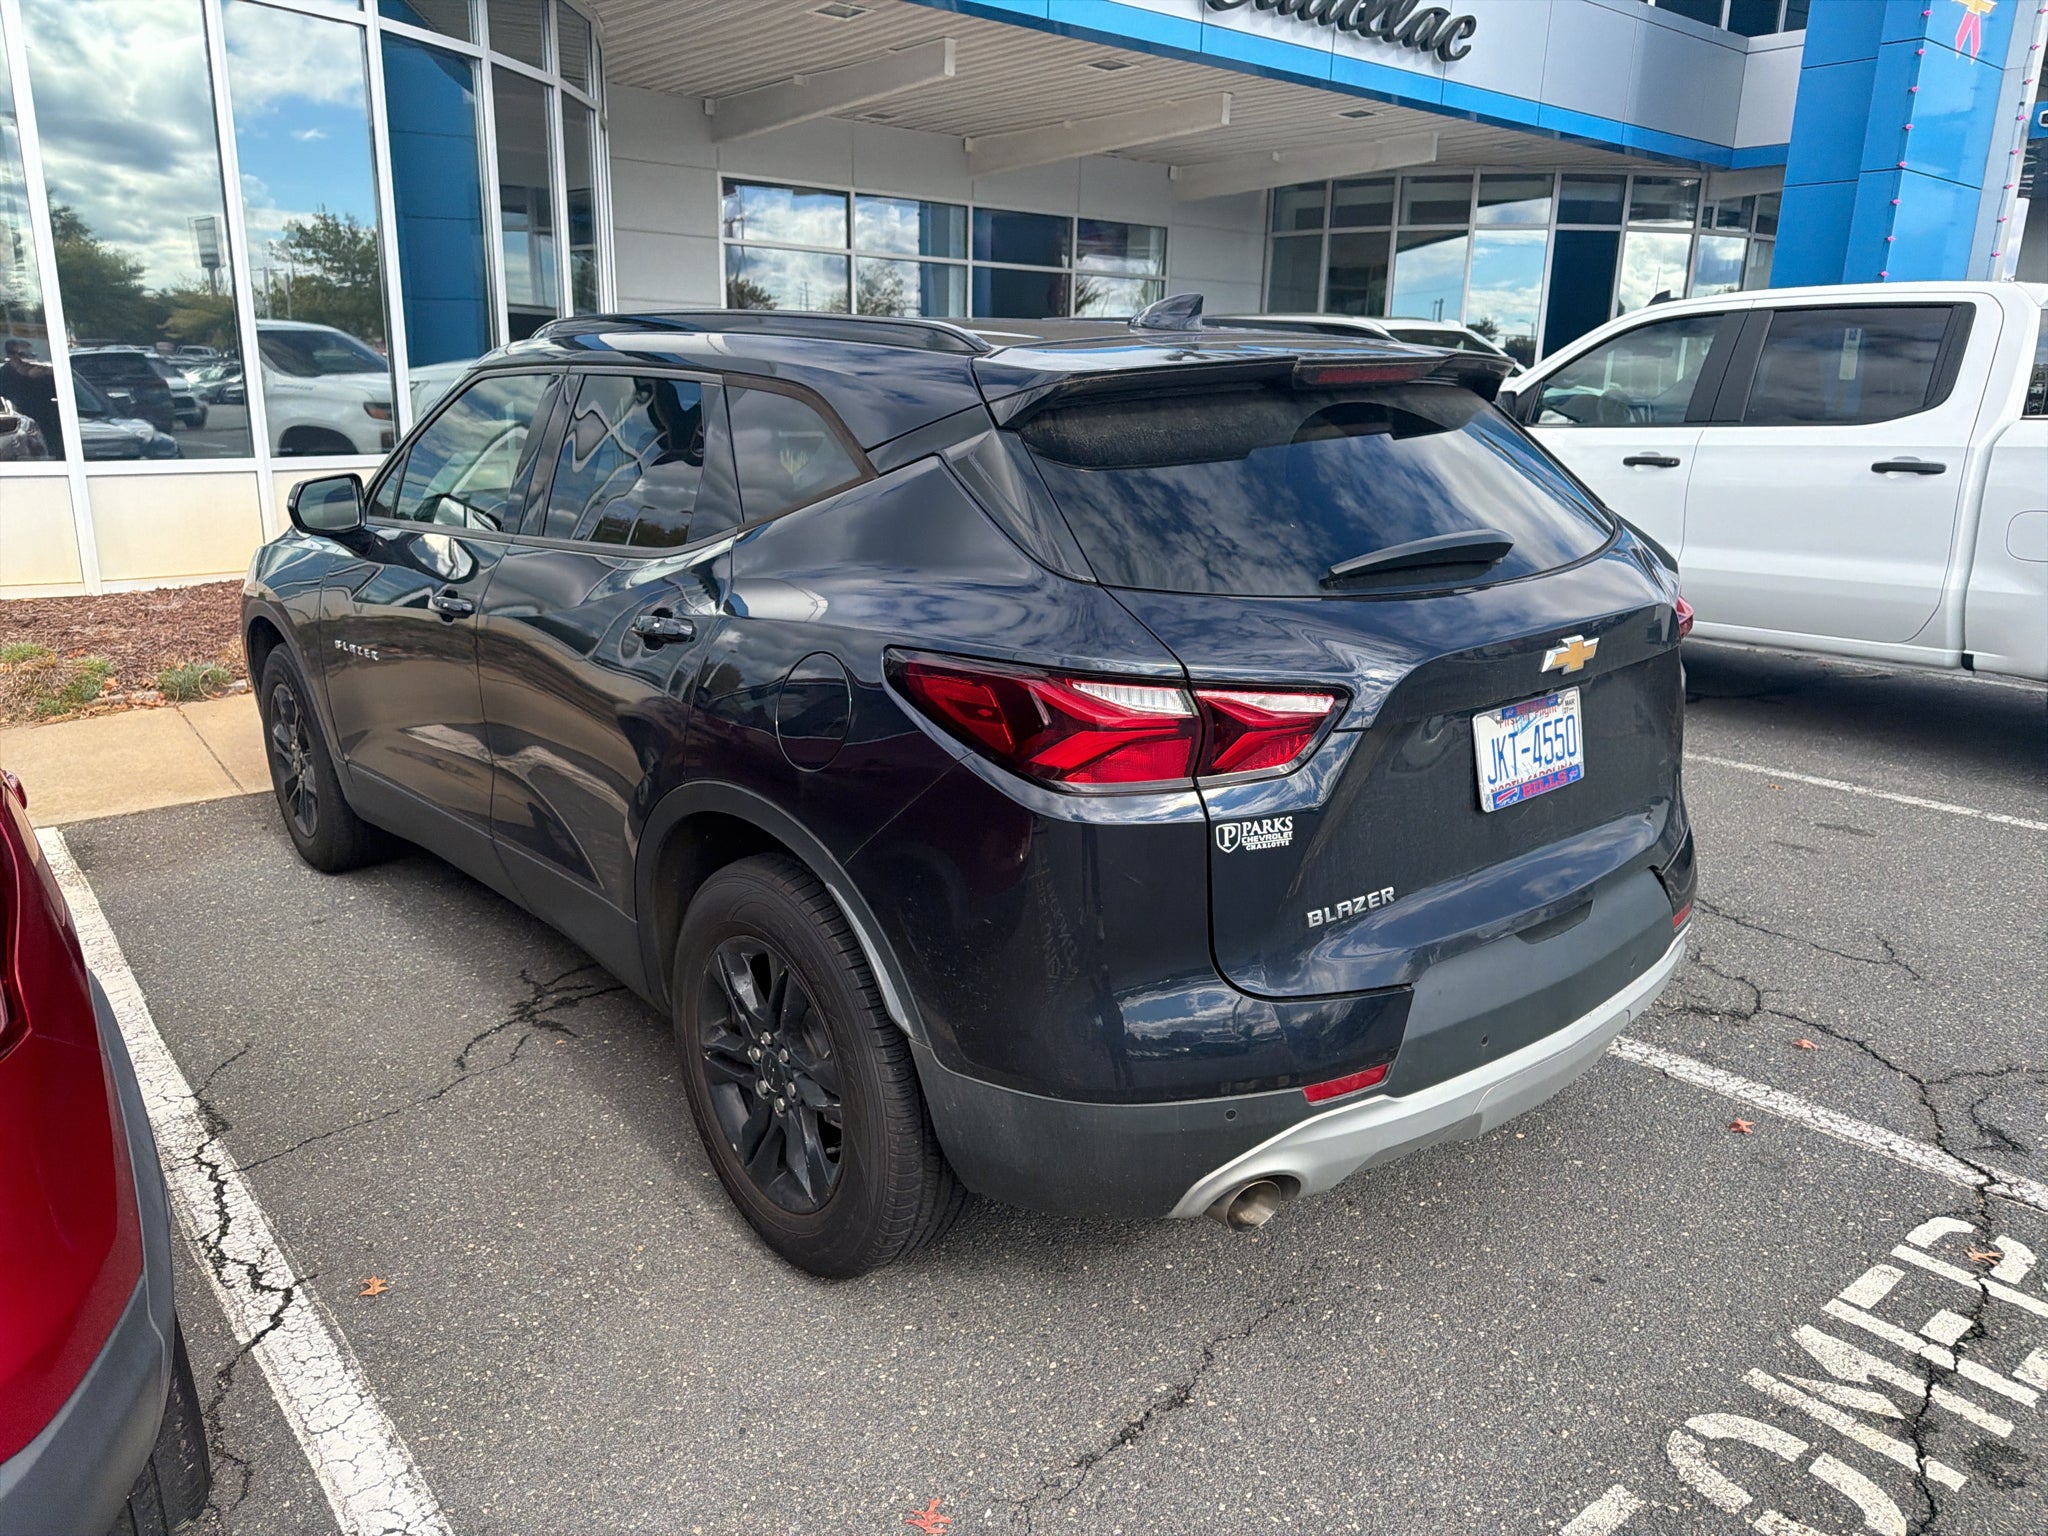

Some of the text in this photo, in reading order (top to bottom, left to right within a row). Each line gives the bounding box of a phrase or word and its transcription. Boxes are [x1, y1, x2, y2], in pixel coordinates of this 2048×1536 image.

[1205, 0, 1477, 62] illac
[1487, 714, 1577, 784] JKT-4550
[1522, 770, 1568, 798] BILLS
[1222, 826, 1237, 847] P
[1241, 816, 1293, 836] PARKS
[1241, 831, 1293, 844] CHEVROLET
[1246, 840, 1290, 851] CHARLOTTE
[1307, 886, 1395, 928] BLAZER
